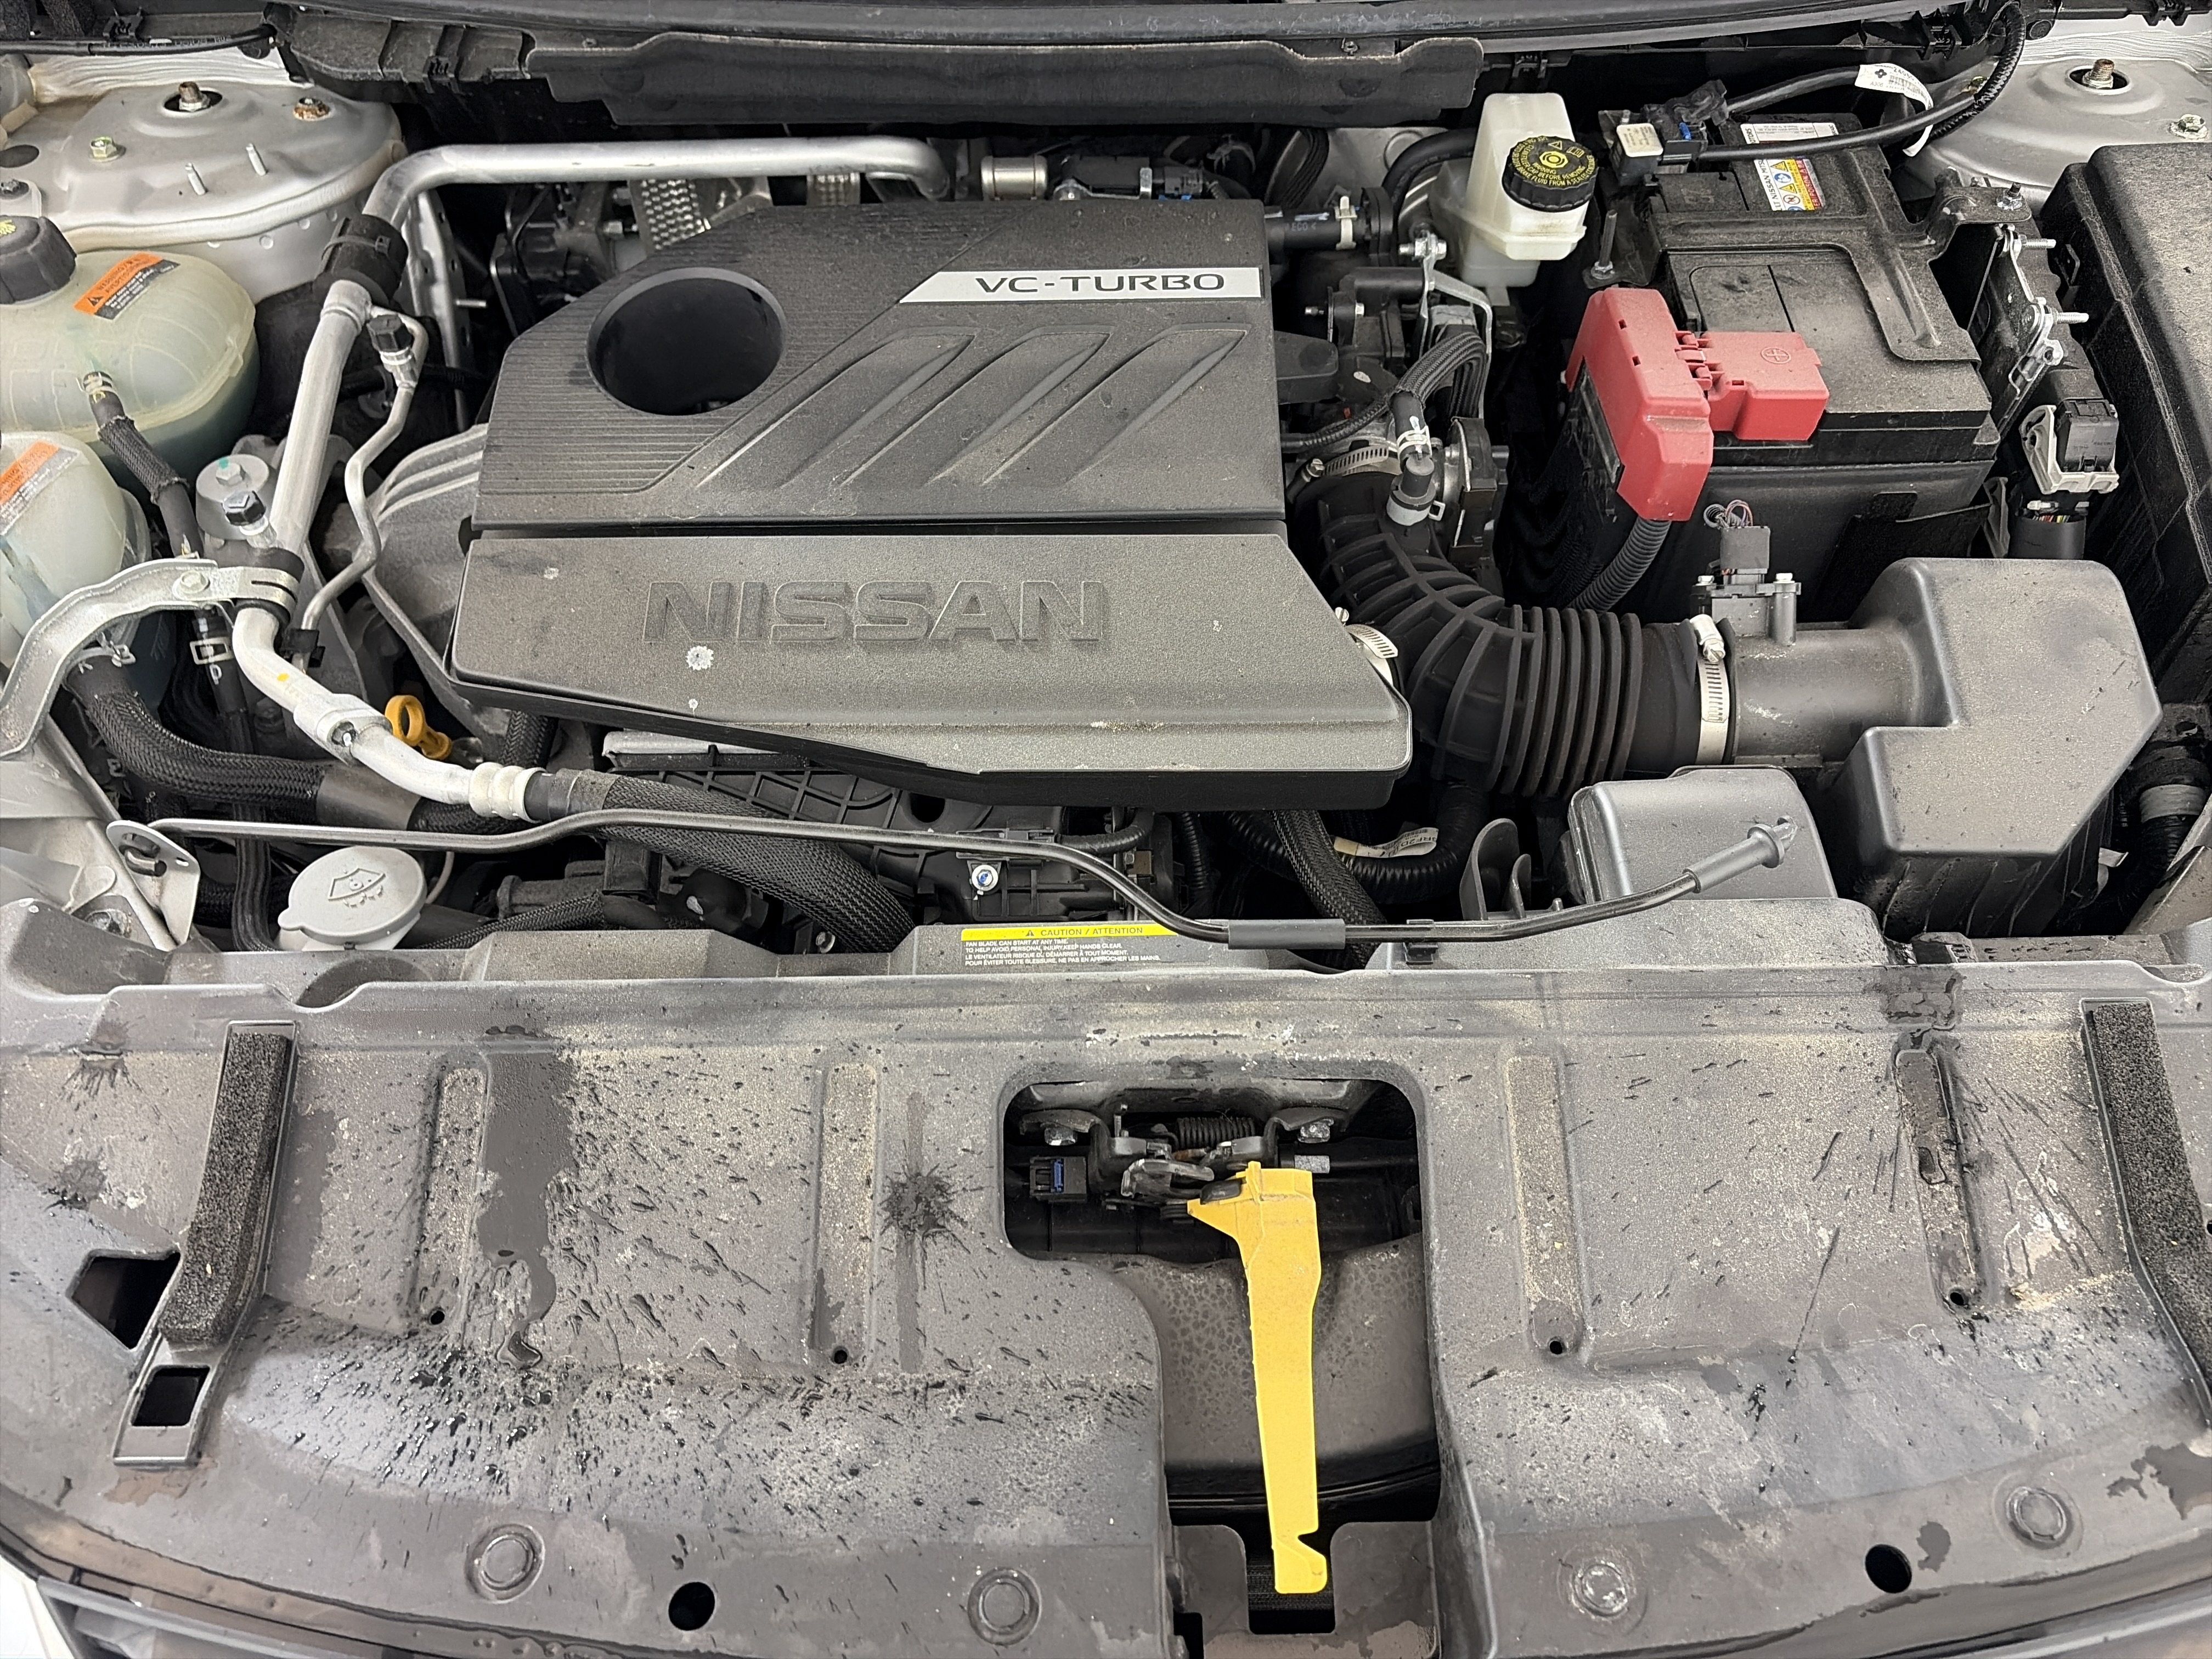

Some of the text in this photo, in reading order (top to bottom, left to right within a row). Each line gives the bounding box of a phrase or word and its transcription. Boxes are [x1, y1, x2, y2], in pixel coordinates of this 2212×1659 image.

[1763, 175, 1778, 201] NISSAN
[975, 273, 1224, 295] VC-TURBO
[642, 579, 1106, 645] NISSAN
[1041, 928, 1082, 936] CAUTION
